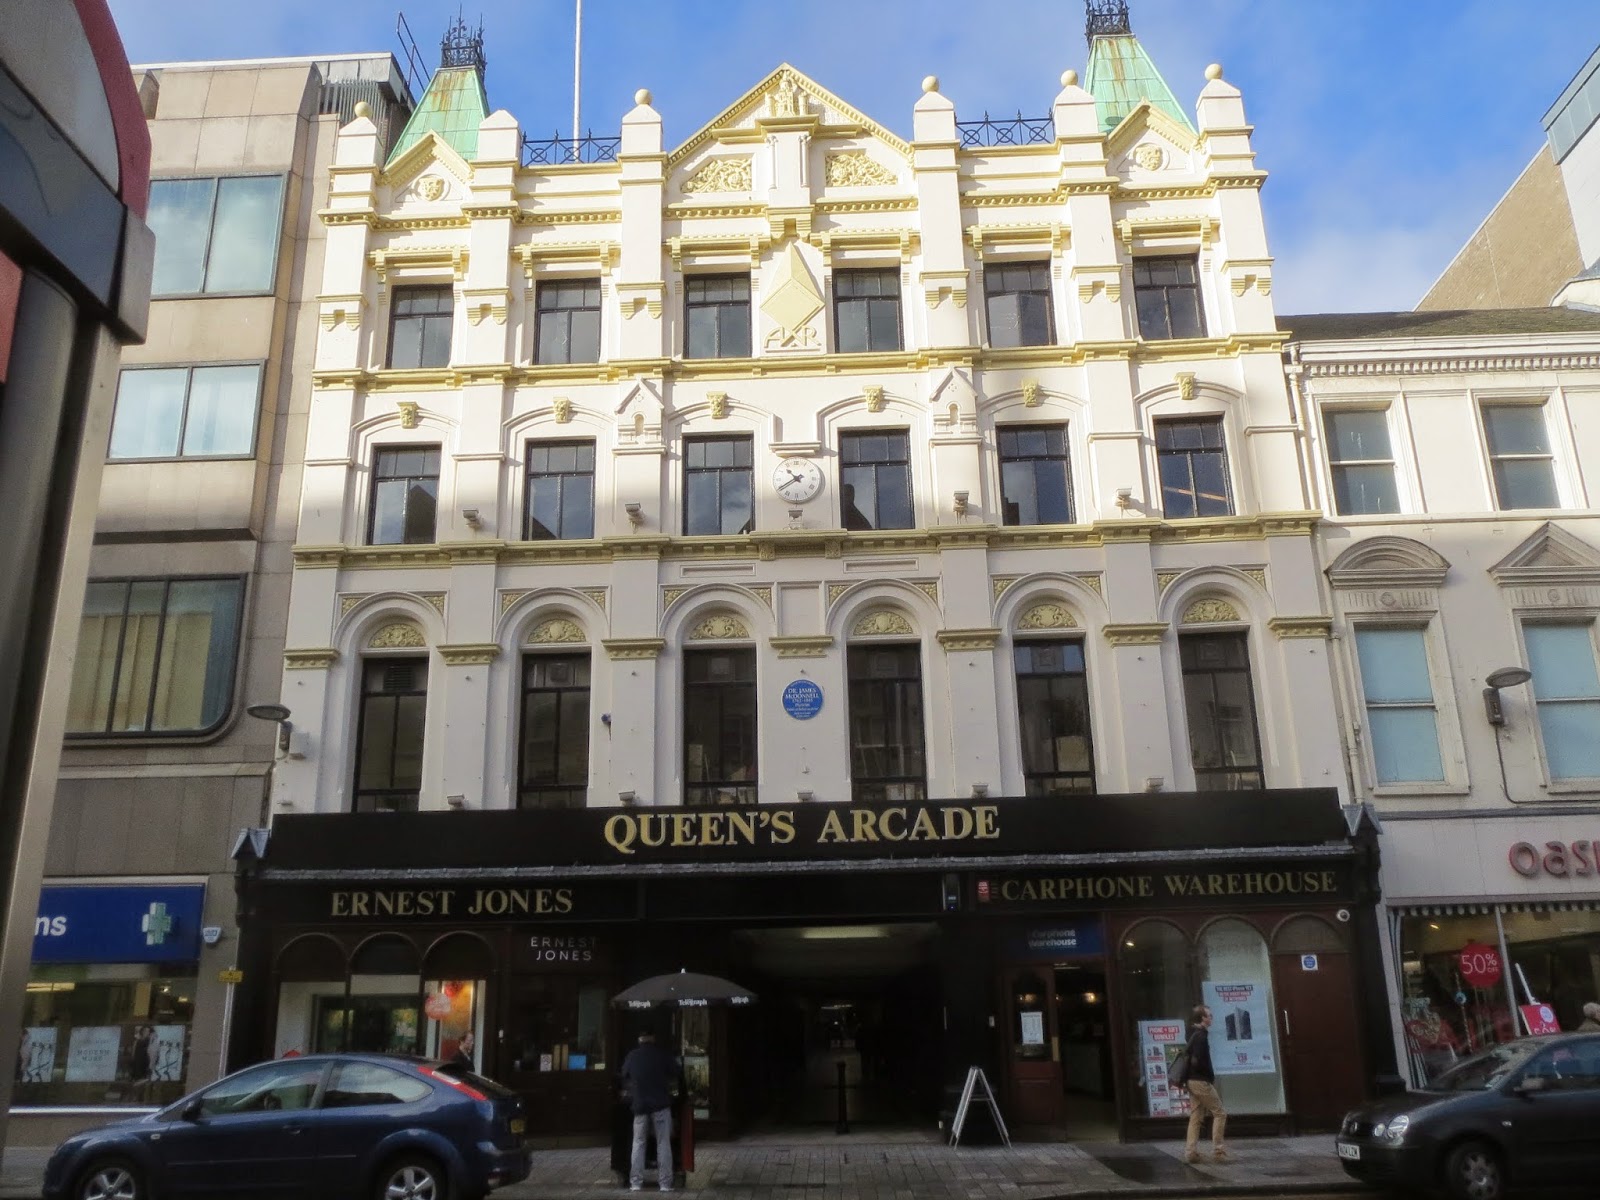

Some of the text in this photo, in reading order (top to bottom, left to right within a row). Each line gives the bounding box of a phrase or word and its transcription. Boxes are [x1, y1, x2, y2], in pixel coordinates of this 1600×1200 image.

[604, 805, 1001, 854] QUEEN'S ARCADE
[1001, 876, 1153, 900] CARPHONE
[1164, 871, 1337, 896] WAREHOUSE
[331, 889, 573, 916] ERNEST JONES
[530, 936, 597, 947] ERNEST
[536, 950, 592, 960] JONES
[1461, 953, 1498, 974] 50%
[678, 998, 708, 1006] Telegraph
